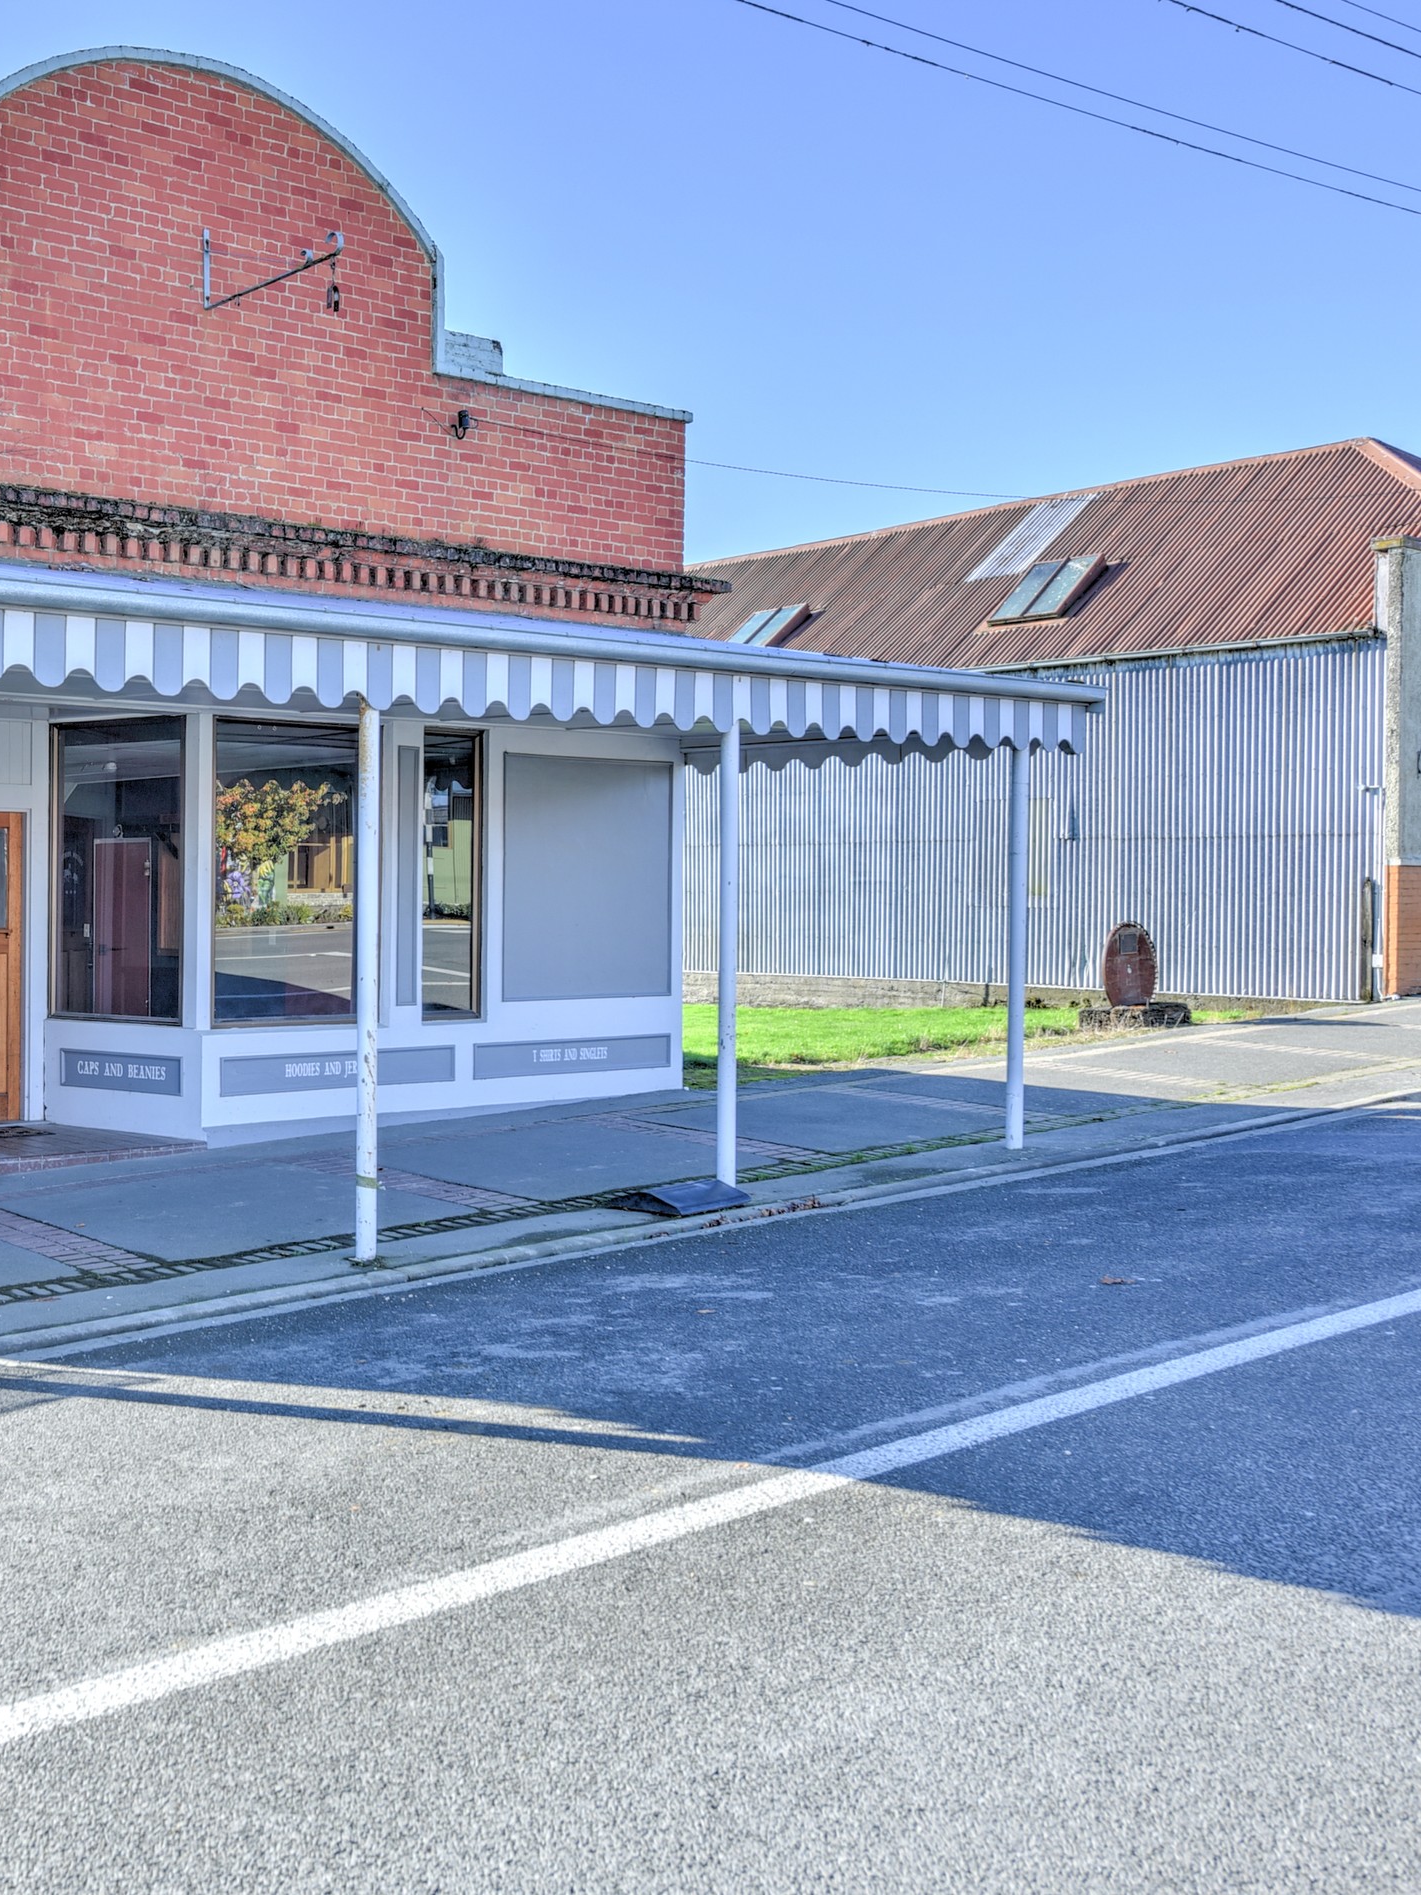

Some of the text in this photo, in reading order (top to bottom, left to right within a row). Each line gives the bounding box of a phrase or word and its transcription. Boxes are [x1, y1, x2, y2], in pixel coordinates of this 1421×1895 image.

[532, 1049, 538, 1063] T
[539, 1048, 562, 1062] SHIRTS
[563, 1047, 578, 1061] AND
[77, 1060, 167, 1081] CAPS AND BEANIES
[285, 1060, 358, 1079] HOODIES AND JER
